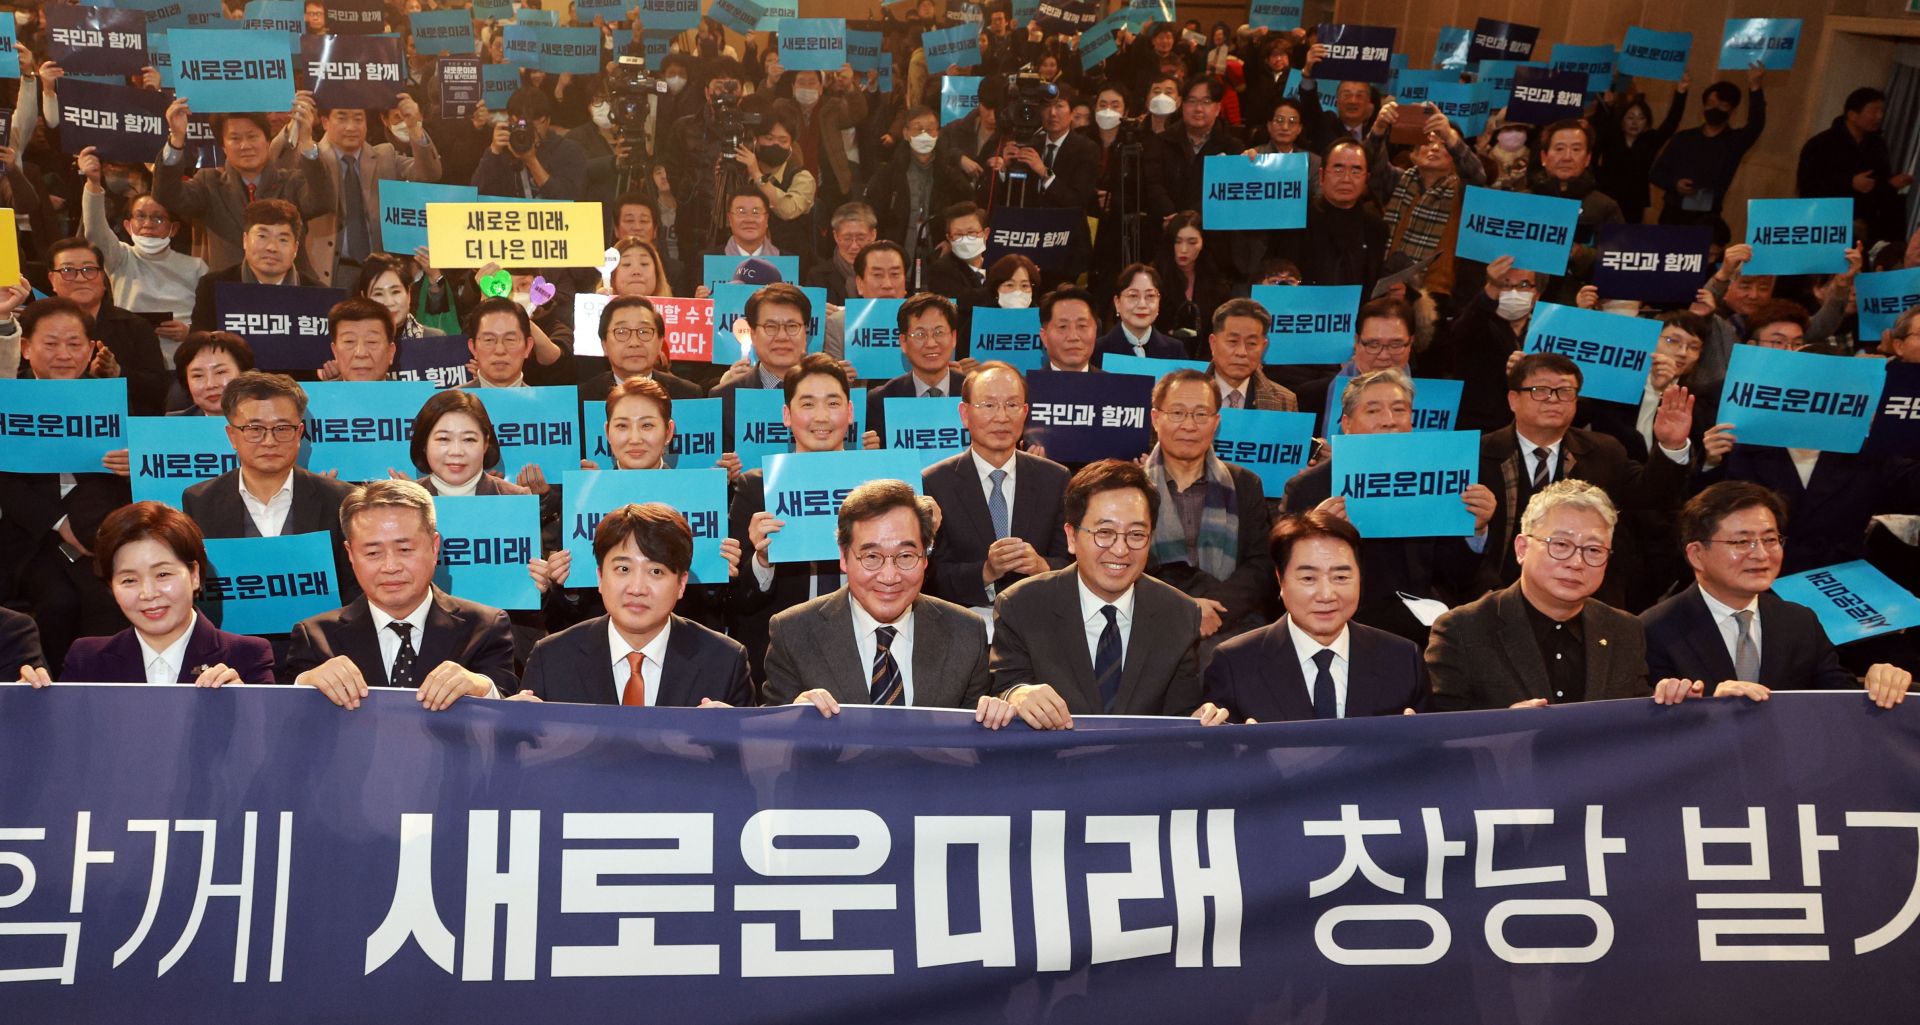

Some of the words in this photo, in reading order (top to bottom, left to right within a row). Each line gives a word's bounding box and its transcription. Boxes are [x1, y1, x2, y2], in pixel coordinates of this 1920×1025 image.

[327, 9, 359, 22] 국민과
[361, 10, 382, 22] 함께
[52, 28, 104, 48] 국민과
[108, 32, 142, 50] 함께
[416, 25, 470, 39] 새로운미래
[1475, 34, 1509, 49] 국민과
[541, 43, 597, 56] 새로운미래
[782, 37, 843, 51] 새로운미래
[1323, 44, 1359, 60] 국민과
[1361, 46, 1389, 61] 함께
[180, 59, 287, 81] 새로운미래
[308, 61, 361, 81] 국민과
[366, 62, 400, 81] 함께
[1515, 86, 1555, 103] 국민과
[1556, 90, 1583, 107] 함께
[64, 106, 119, 131] 국민과
[124, 113, 162, 135] 함께
[1209, 181, 1301, 201] 새로운미래
[385, 206, 427, 227] 새로운
[467, 210, 521, 231] 새로운
[527, 211, 569, 232] 미래,
[994, 229, 1040, 249] 국민과
[1041, 230, 1071, 249] 함께
[1465, 213, 1568, 246] 새로운미래
[1752, 225, 1847, 245] 새로운미래
[465, 239, 483, 260] 더
[490, 238, 525, 260] 나은
[533, 239, 568, 260] 미래
[1602, 250, 1660, 272] 국민과
[1664, 252, 1703, 273] 함께
[736, 268, 756, 278] NYC
[1863, 291, 1920, 315] 새로운
[224, 313, 292, 335] 국민과
[653, 304, 681, 325] 할
[686, 306, 700, 325] 수
[1269, 313, 1351, 335] 로운미래
[669, 331, 706, 354] 있다
[851, 328, 902, 348] 새로운
[976, 333, 1046, 351] 새로운
[1531, 333, 1647, 374] 새로운미래
[425, 364, 468, 388] 함께
[1727, 382, 1870, 418] 새로운미래
[1031, 402, 1096, 427] 국민과
[1101, 405, 1145, 429] 함께
[500, 421, 572, 447] 운미래
[594, 431, 716, 458] 새미래
[893, 428, 971, 450] 새로운
[1213, 439, 1303, 465] 로운미래
[139, 452, 237, 479] 새로운
[1340, 469, 1471, 499] 새로운미래
[776, 489, 854, 518] 새로운
[436, 536, 531, 566] 운미래
[206, 570, 329, 601] 로운미래
[1805, 570, 1892, 629] 새로운미래
[0, 811, 293, 986] 함께
[364, 808, 1243, 982] 새로운미래
[1303, 804, 1627, 966] 창당
